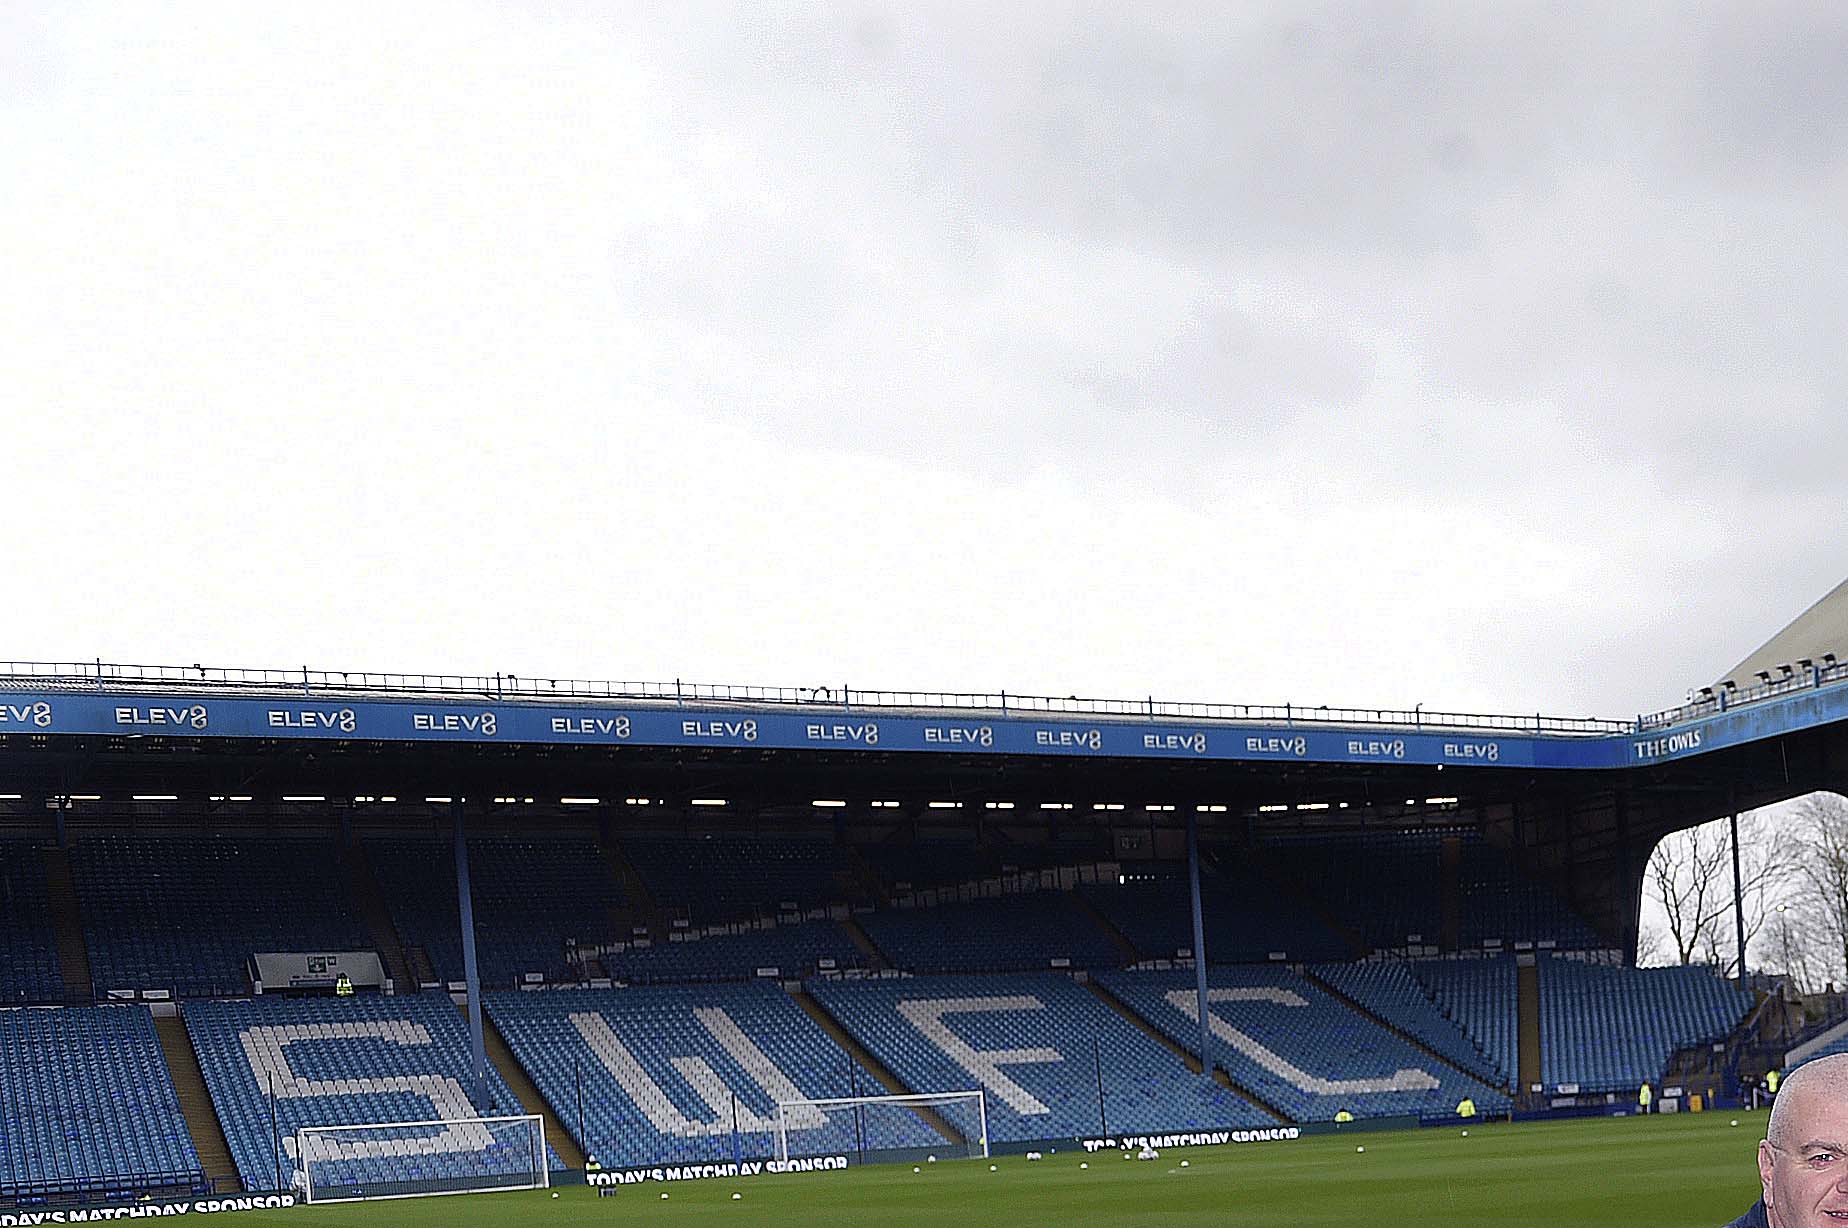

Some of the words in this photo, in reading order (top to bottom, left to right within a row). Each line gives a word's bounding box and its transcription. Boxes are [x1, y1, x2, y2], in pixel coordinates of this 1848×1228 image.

[115, 704, 208, 729] ELEV8
[268, 708, 356, 733] ELEV8
[413, 711, 497, 735] ELEV8
[552, 715, 631, 738] ELEV8
[683, 719, 757, 742] ELEV8
[806, 723, 878, 745] ELEV8
[925, 726, 992, 747] ELEV8
[1036, 729, 1101, 750] ELEV8
[1144, 732, 1206, 753] ELEV8
[1246, 736, 1306, 756] ELEV8
[1348, 740, 1404, 759] ELEV8
[1444, 743, 1498, 762] ELEV8
[1634, 738, 1668, 758] THE
[1668, 729, 1700, 753] OWLS
[1083, 1136, 1149, 1152] TODY'S
[587, 1170, 664, 1185] TODAY'S
[666, 1162, 761, 1180] MATCHDAY
[766, 1156, 848, 1173] SPONSOR
[0, 1211, 66, 1227] DAY'S
[69, 1203, 190, 1222] MATCHDAY
[195, 1195, 294, 1213] SPONSOR
